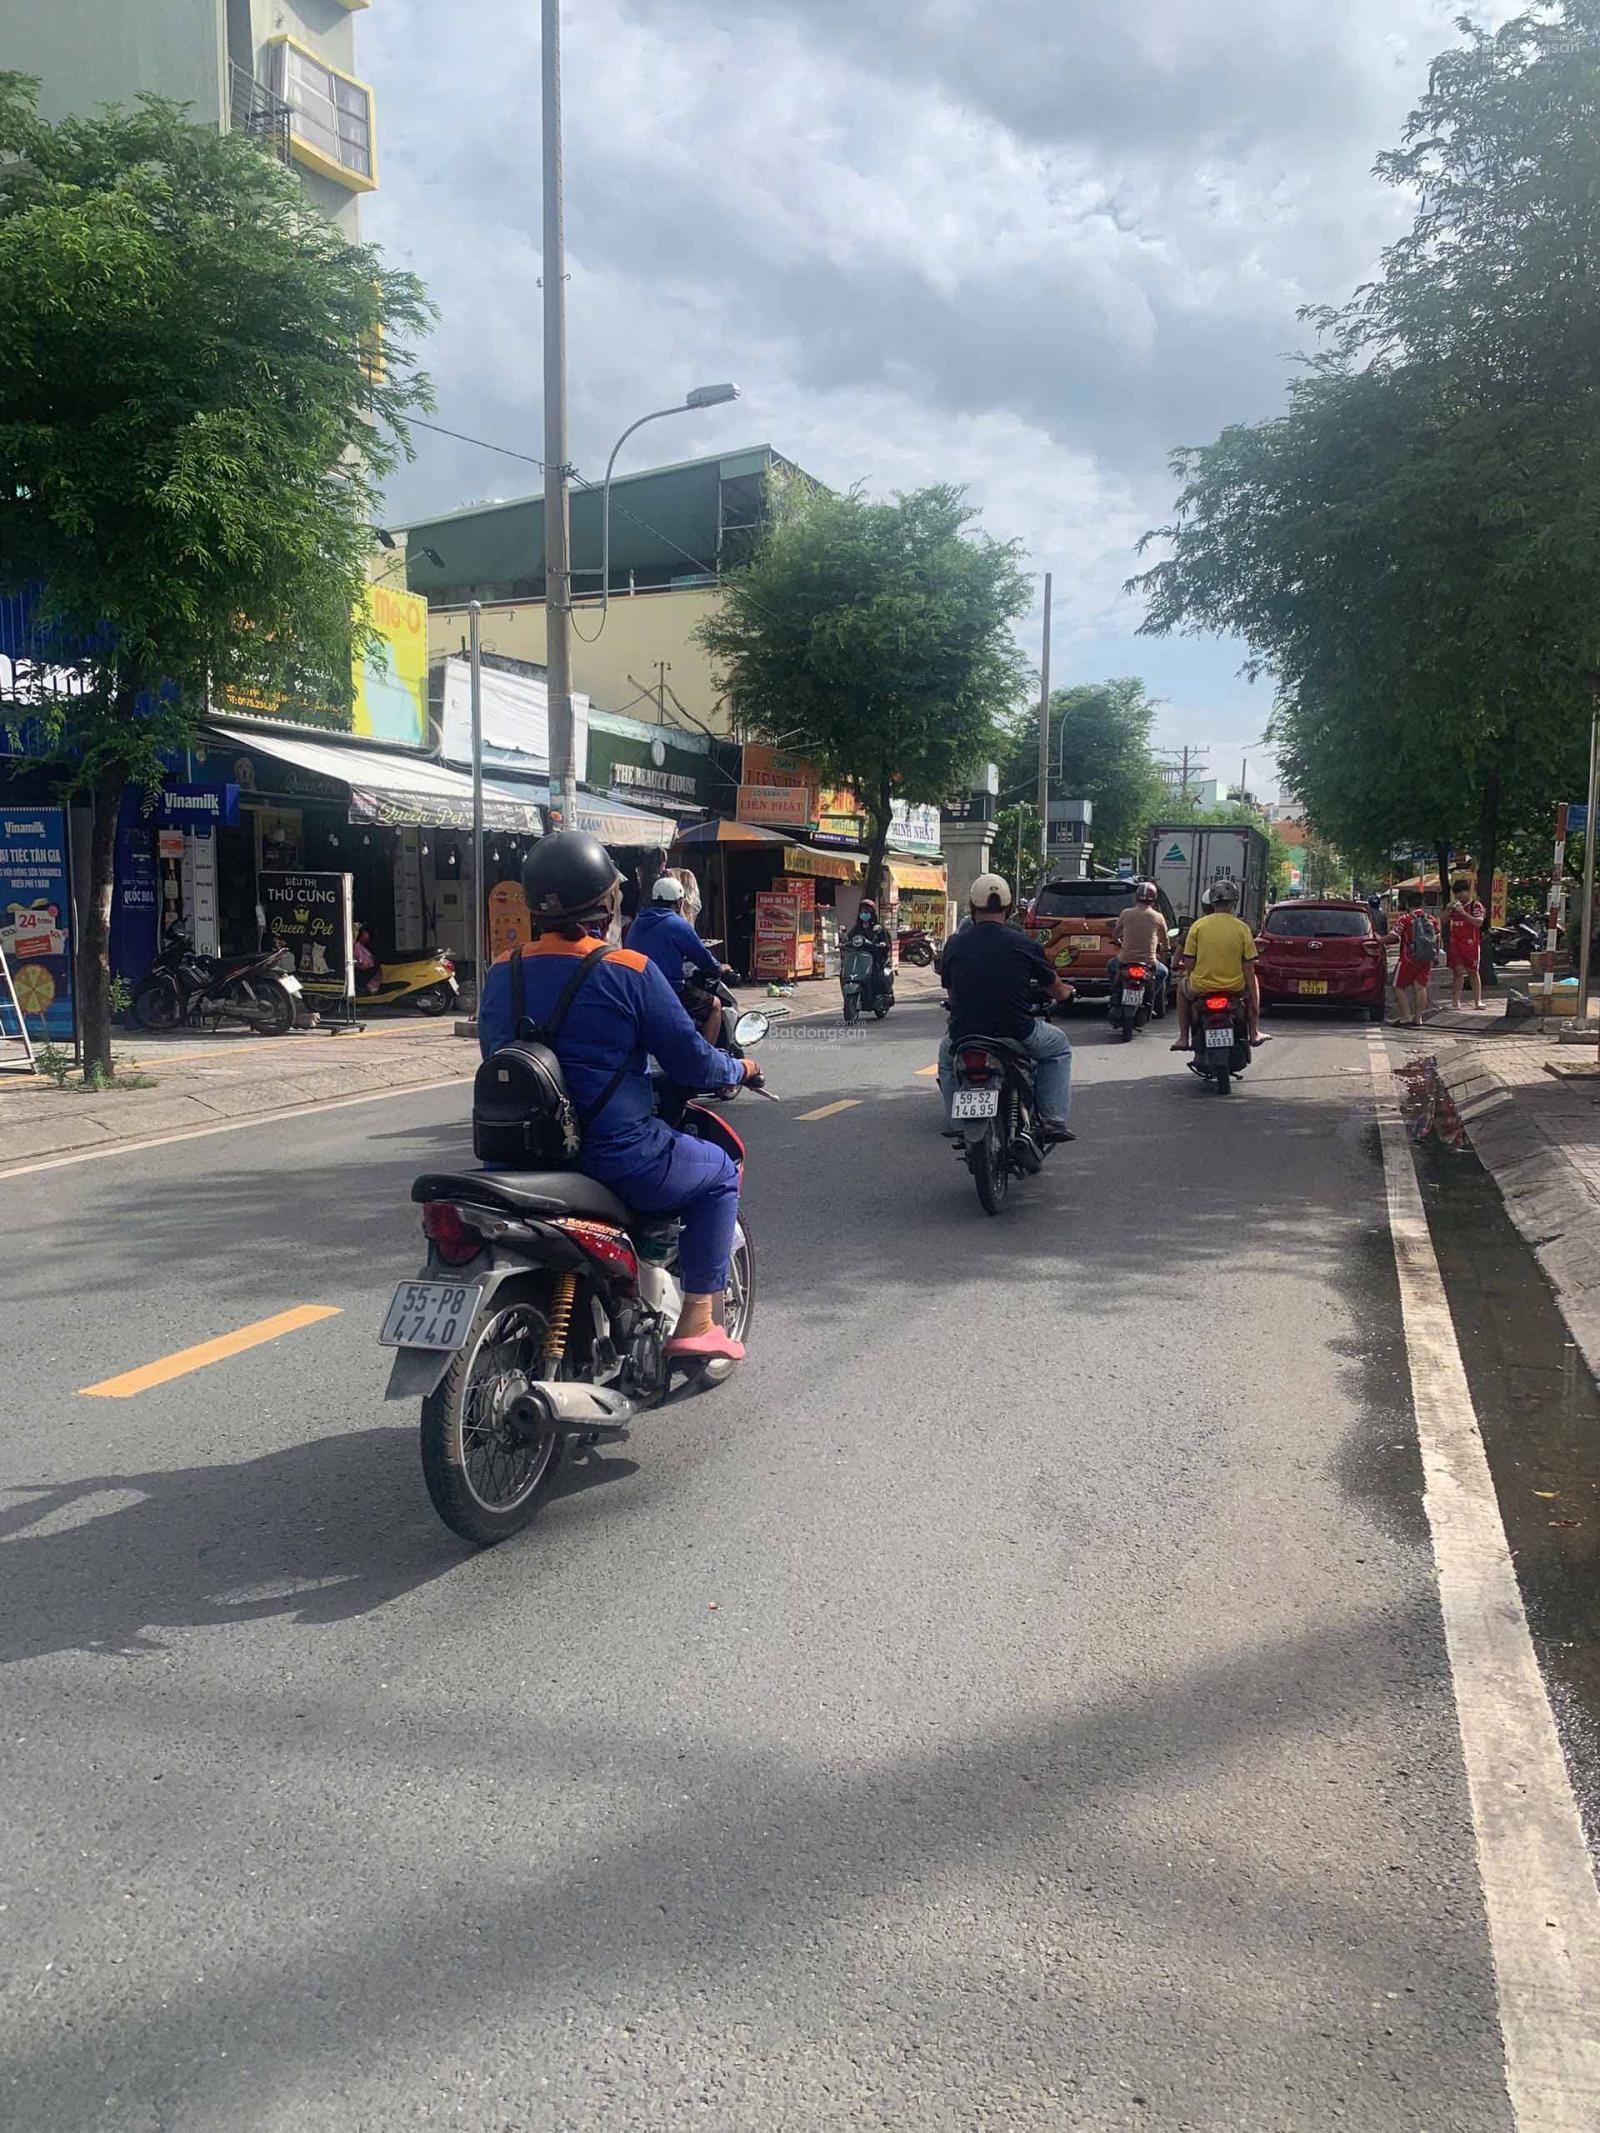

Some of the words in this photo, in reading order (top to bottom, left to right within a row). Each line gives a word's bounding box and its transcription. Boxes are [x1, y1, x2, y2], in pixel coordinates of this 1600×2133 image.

[165, 793, 220, 810] Vinamilk
[378, 801, 430, 824] Queen
[436, 805, 466, 825] Pet
[4, 821, 46, 834] Vinamilk
[19, 914, 37, 928] 24
[271, 916, 307, 937] Queen
[310, 918, 335, 937] Pet
[960, 1092, 991, 1105] 59-S2
[956, 1103, 994, 1117] 146.95
[403, 1286, 466, 1315] 55-P8
[393, 1314, 457, 1345] 4740
